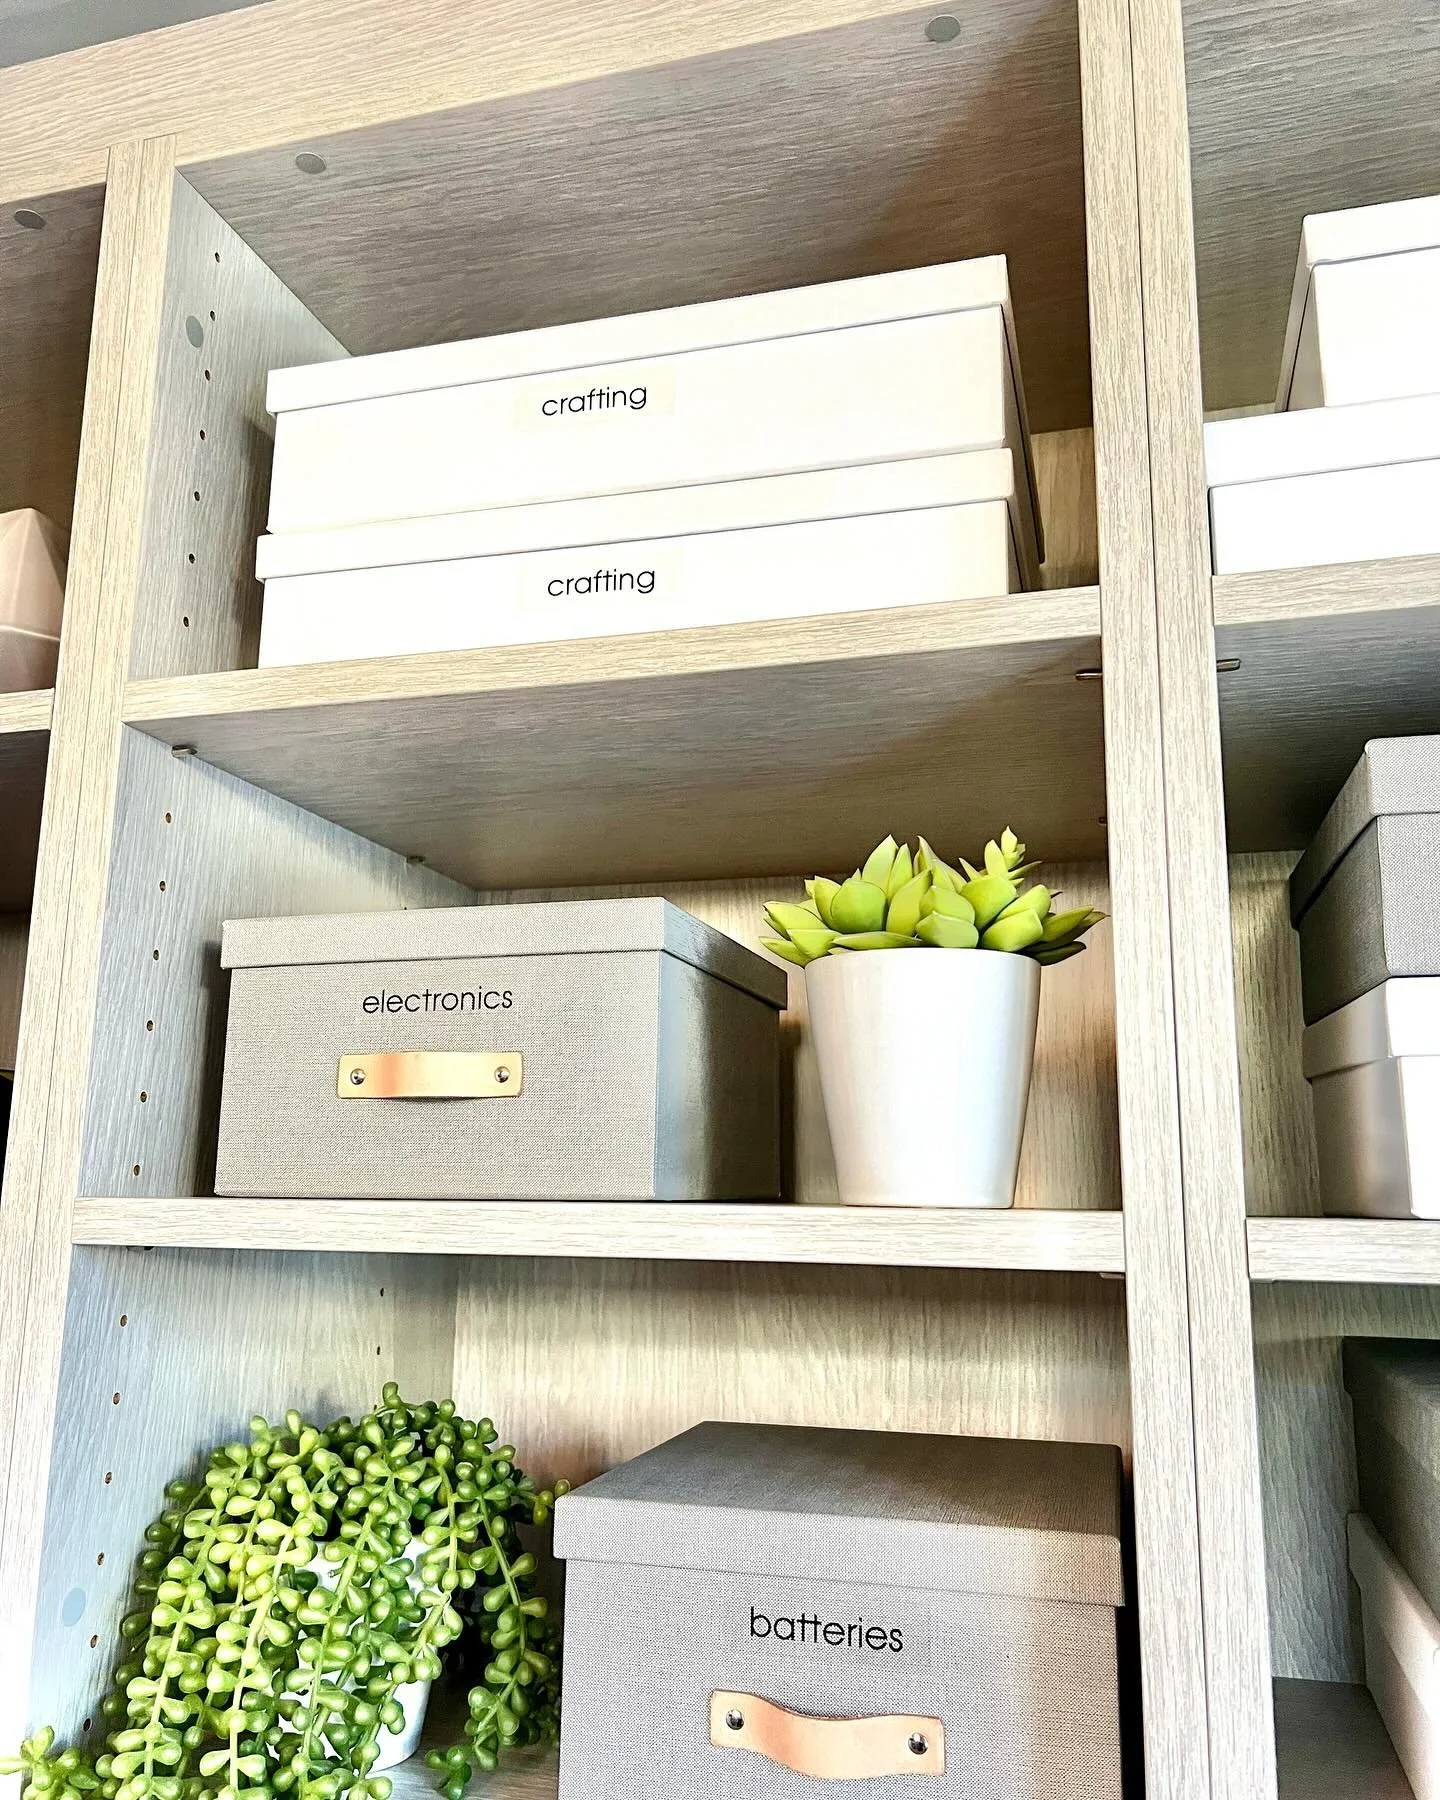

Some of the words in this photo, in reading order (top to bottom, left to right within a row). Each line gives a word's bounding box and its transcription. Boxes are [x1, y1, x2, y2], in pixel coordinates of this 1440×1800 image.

[541, 386, 646, 415] crafting
[547, 568, 655, 596] crafting
[362, 985, 513, 1014] electronics
[749, 1606, 904, 1652] batteries
